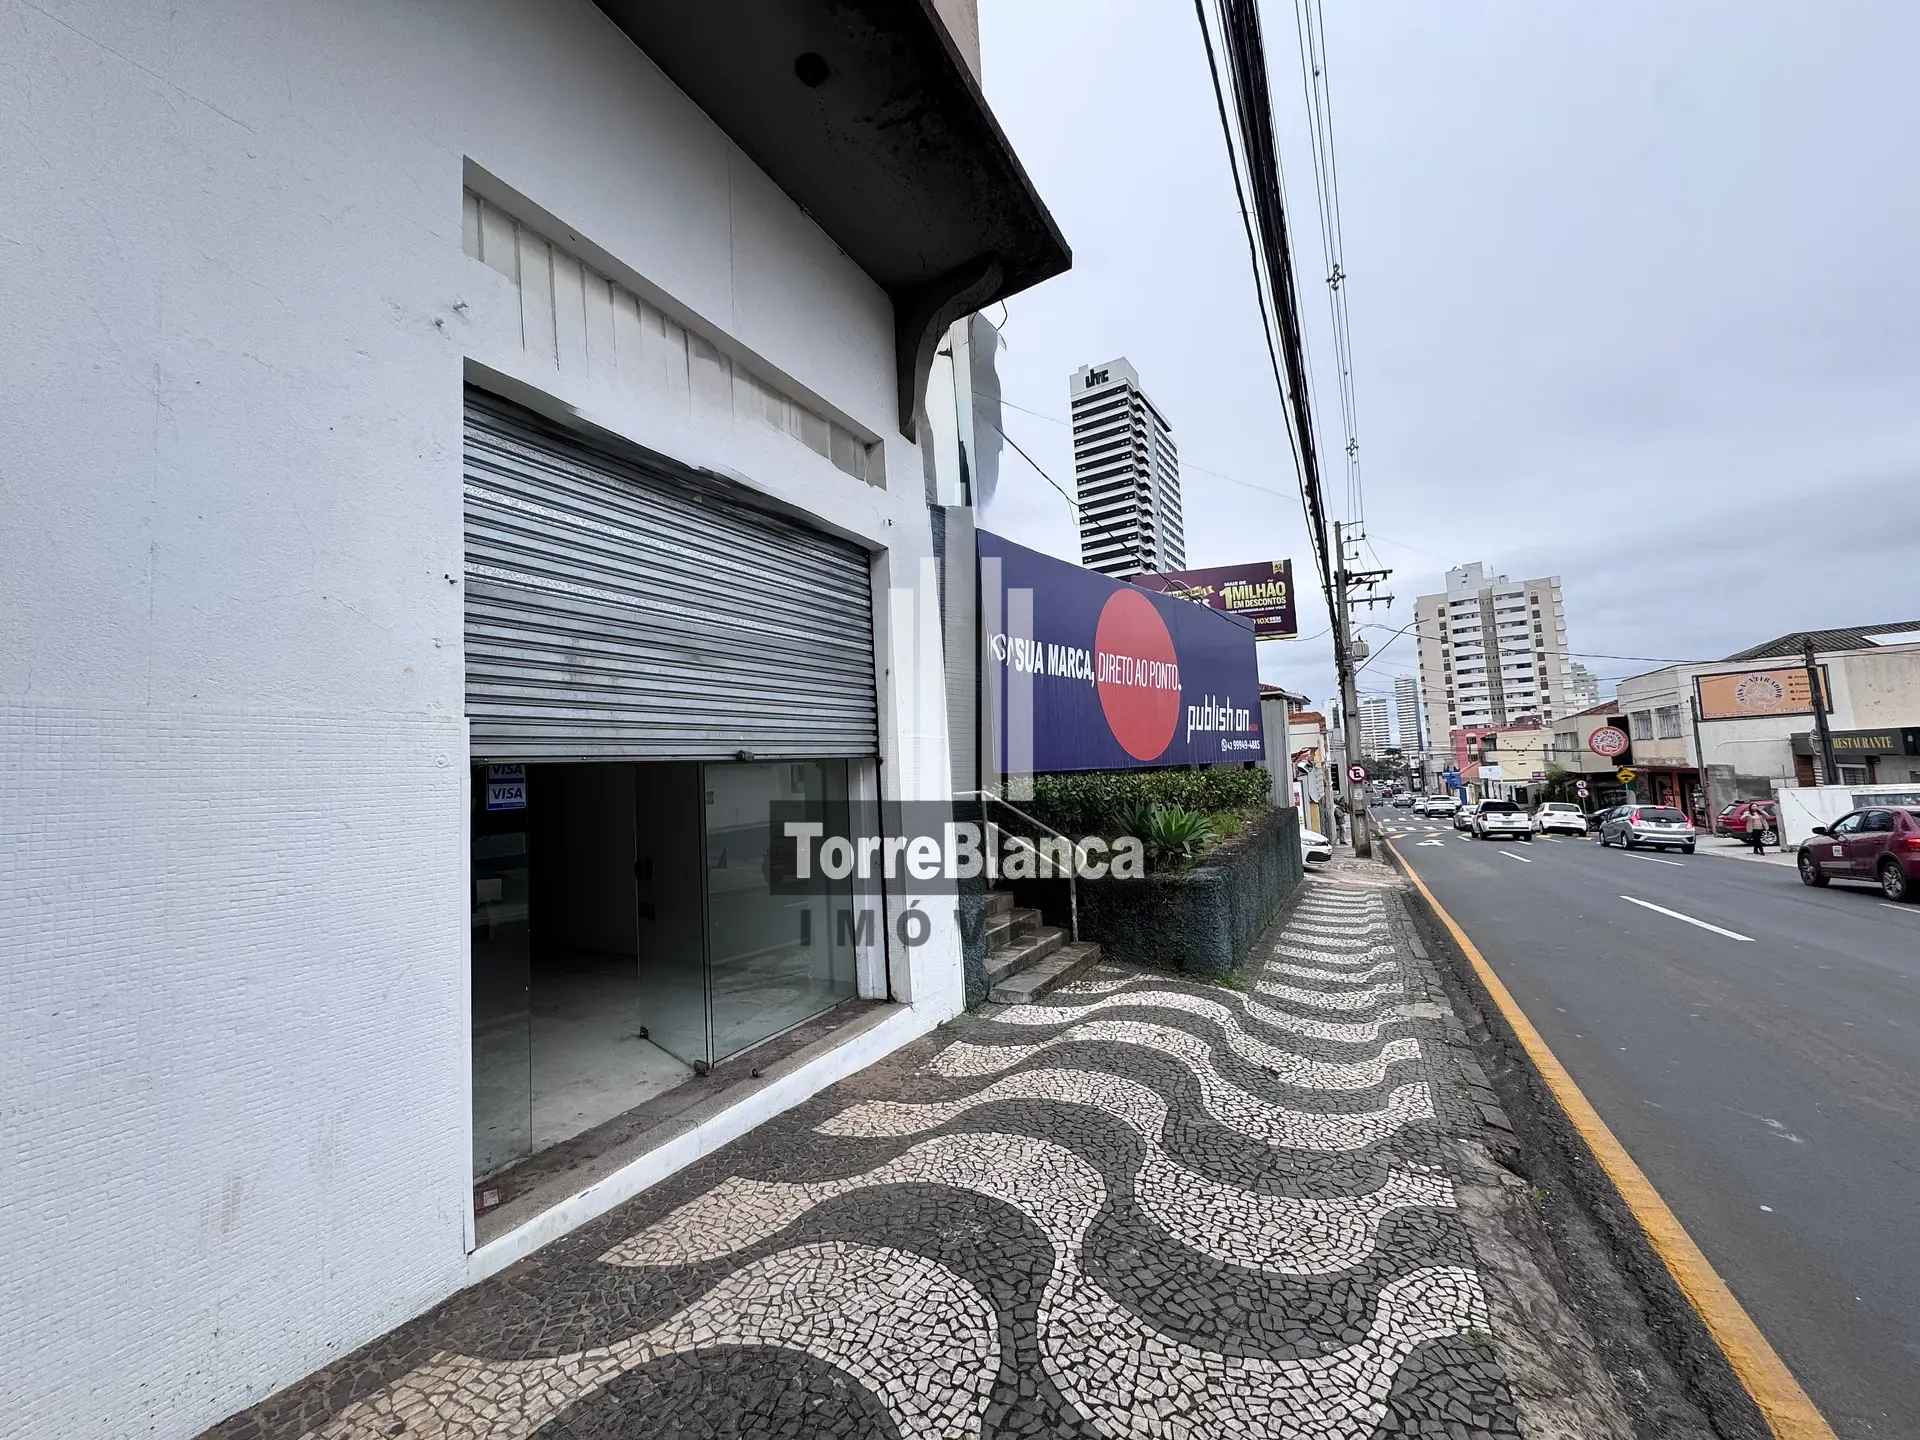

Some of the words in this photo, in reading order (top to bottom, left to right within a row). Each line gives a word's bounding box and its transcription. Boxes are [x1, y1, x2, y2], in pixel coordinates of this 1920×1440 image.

[1219, 586, 1233, 610] 1
[1231, 579, 1287, 601] MILHÃO
[1233, 600, 1245, 609] EM
[1244, 596, 1287, 608] DESCONTOS
[1014, 637, 1044, 674] SUA
[1047, 643, 1095, 688] MARCA,
[1097, 651, 1133, 686] DIRETO
[1134, 658, 1148, 688] AO
[1149, 660, 1183, 692] PONTO.
[1832, 736, 1894, 749] RESTAURANTE
[492, 764, 523, 775] VISA
[491, 787, 524, 800] VISA
